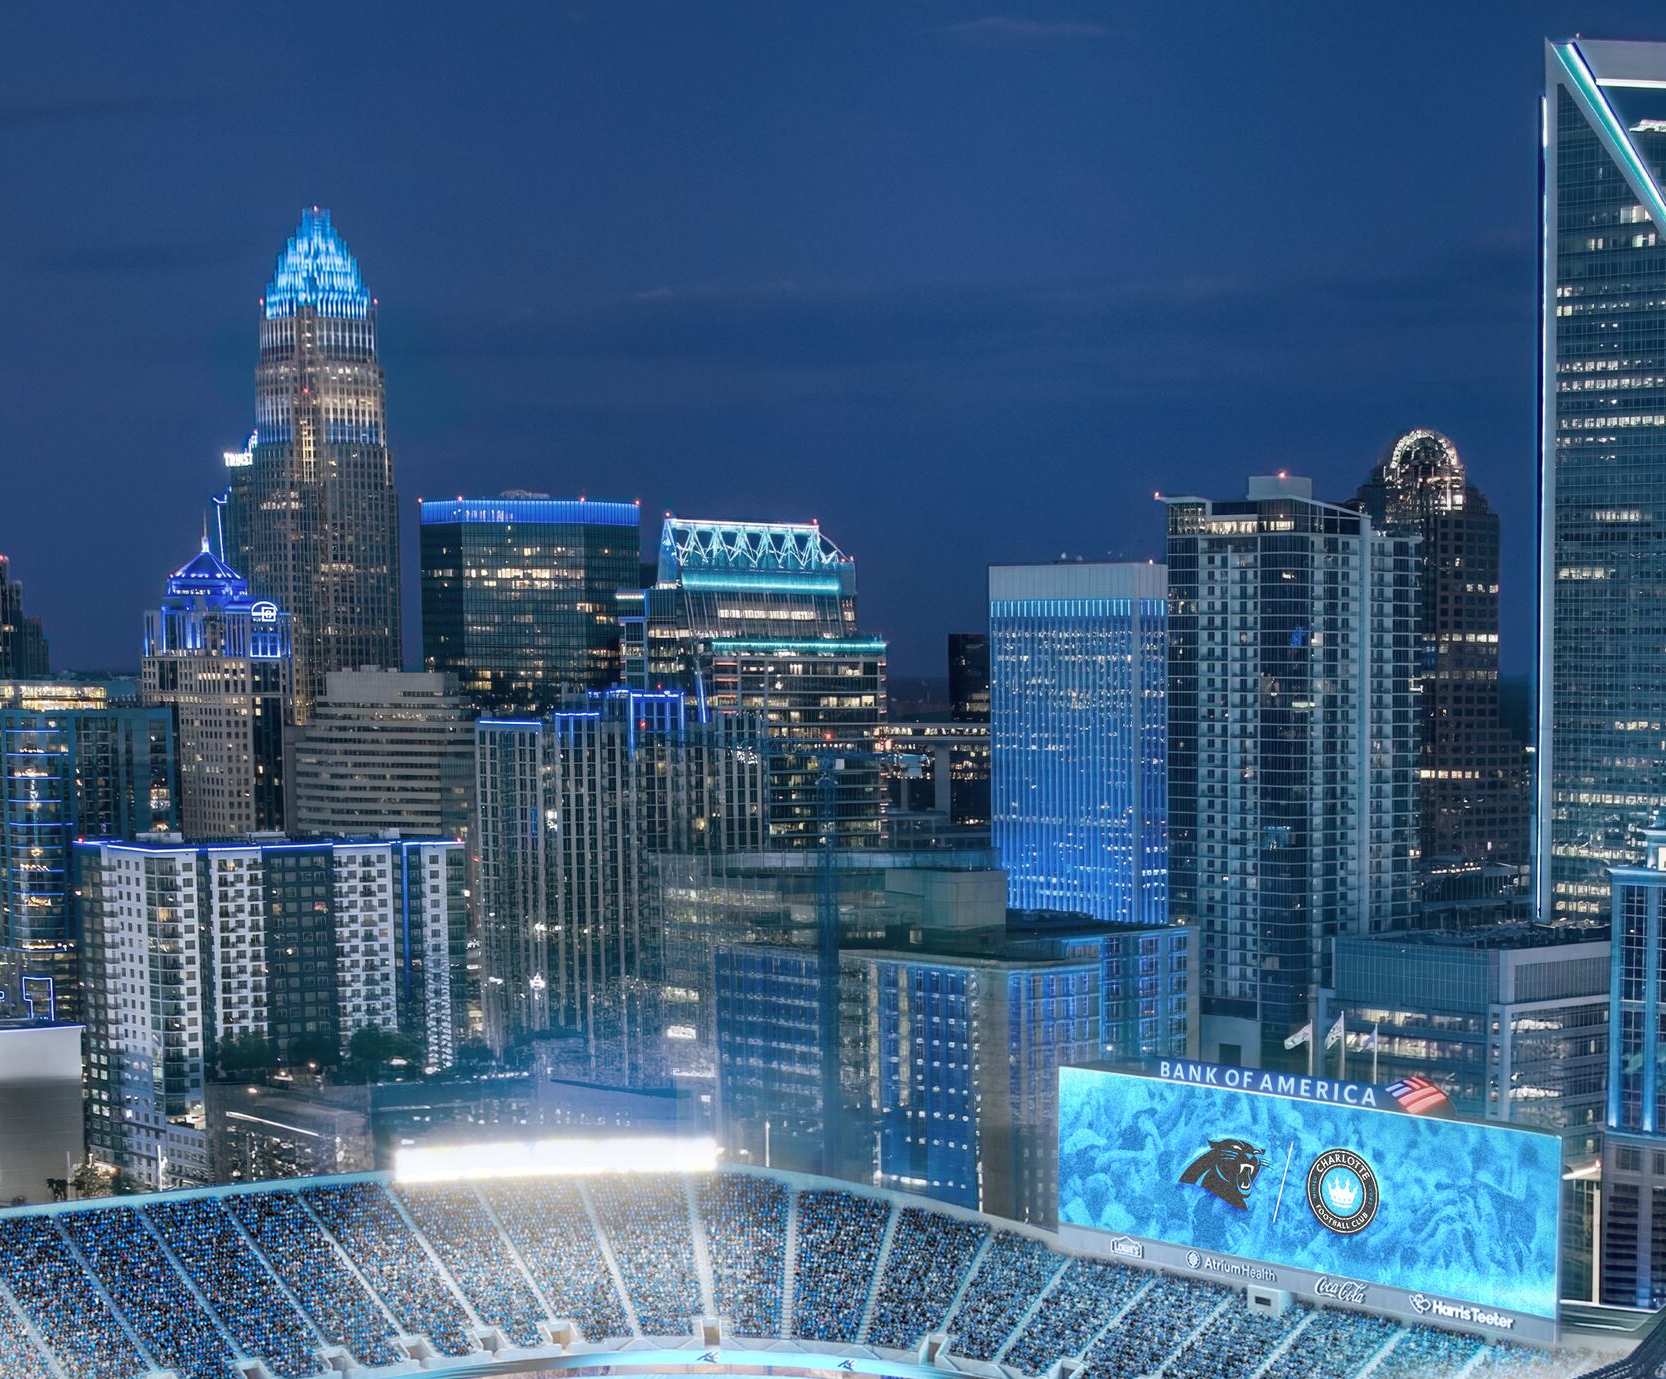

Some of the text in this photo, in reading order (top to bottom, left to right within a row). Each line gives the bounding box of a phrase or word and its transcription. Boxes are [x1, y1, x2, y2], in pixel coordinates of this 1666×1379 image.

[1160, 1061, 1377, 1106] BANK OF AMERICA
[1316, 1153, 1370, 1180] CHARLOTTE
[1315, 1204, 1369, 1230] FOOTBALL CLUB
[1432, 1300, 1513, 1329] Harris Teeter
